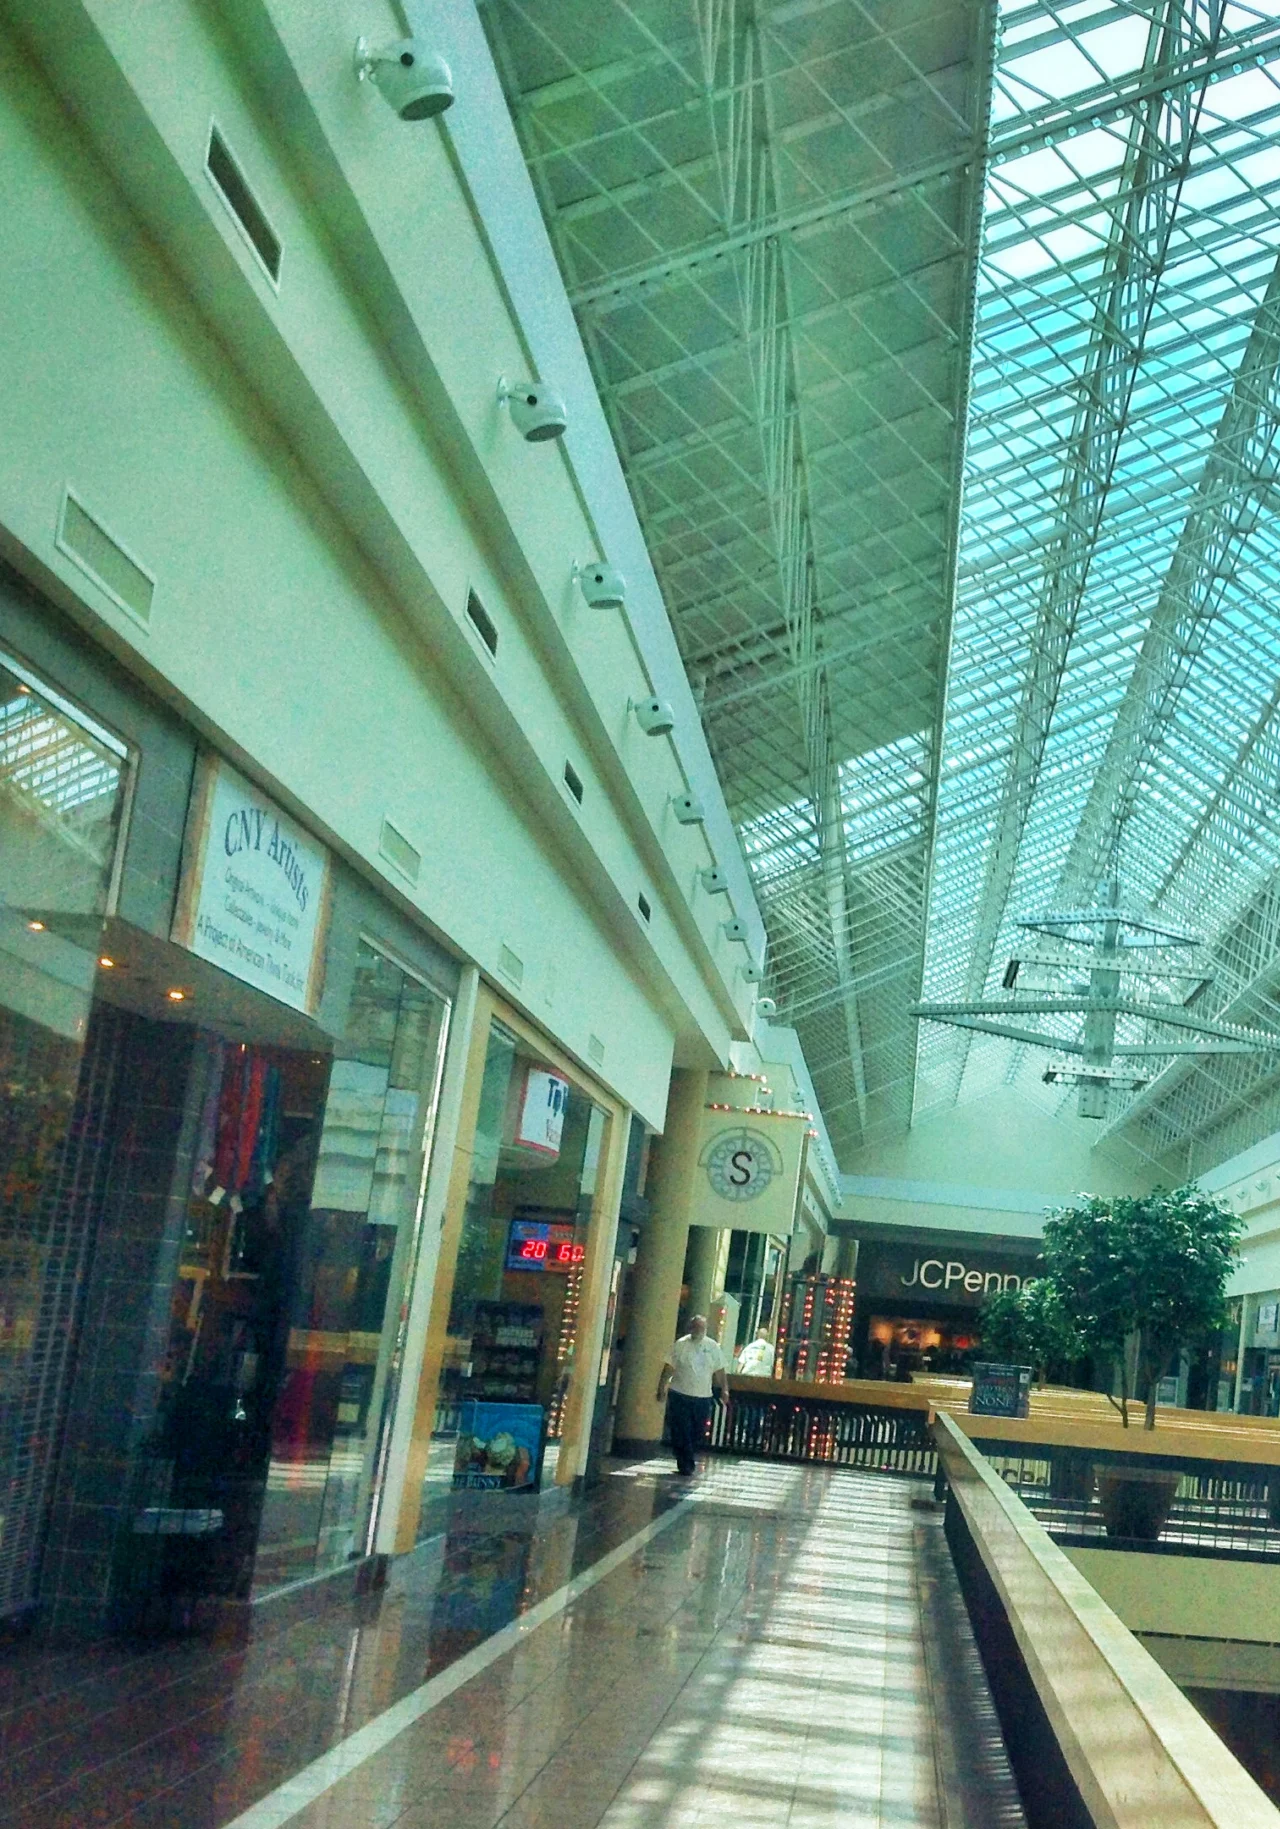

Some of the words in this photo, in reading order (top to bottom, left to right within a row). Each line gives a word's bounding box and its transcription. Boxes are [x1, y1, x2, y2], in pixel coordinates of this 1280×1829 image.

[225, 809, 268, 857] CNY
[267, 820, 309, 912] Artists
[730, 1151, 752, 1186] S
[522, 1241, 547, 1258] 20
[558, 1244, 584, 1262] 60
[900, 1257, 1040, 1293] JCPenne
